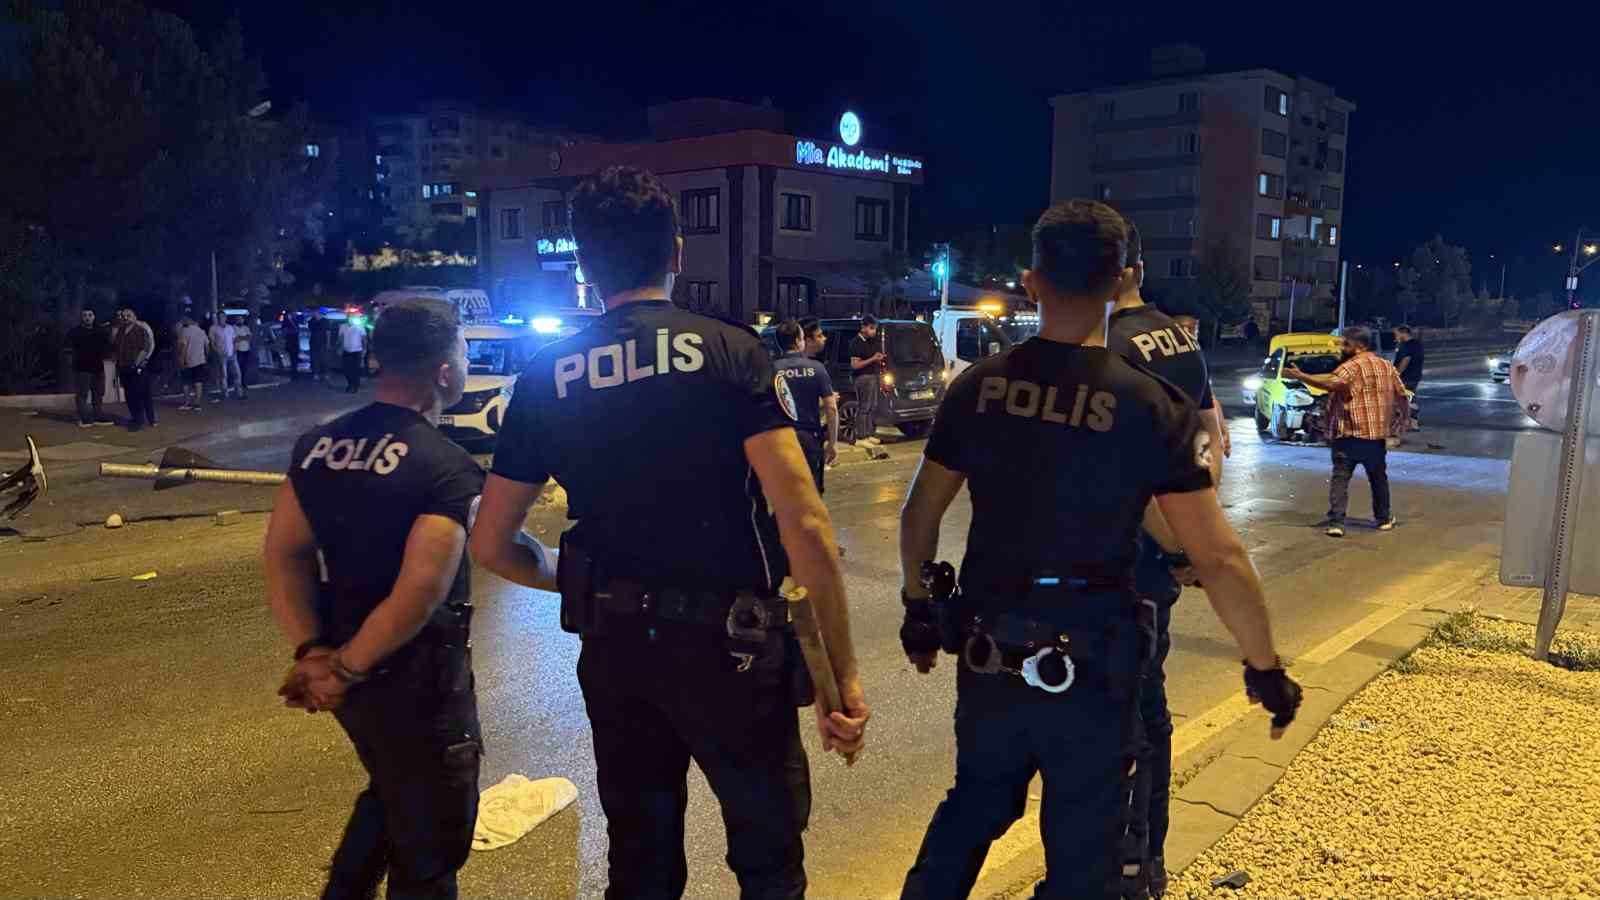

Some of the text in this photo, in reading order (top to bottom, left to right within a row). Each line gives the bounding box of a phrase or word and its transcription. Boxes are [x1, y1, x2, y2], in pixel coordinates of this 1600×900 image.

[796, 140, 824, 165] Mia
[827, 146, 889, 173] Akademi
[554, 328, 705, 399] POLİS
[300, 433, 409, 475] POLİS
